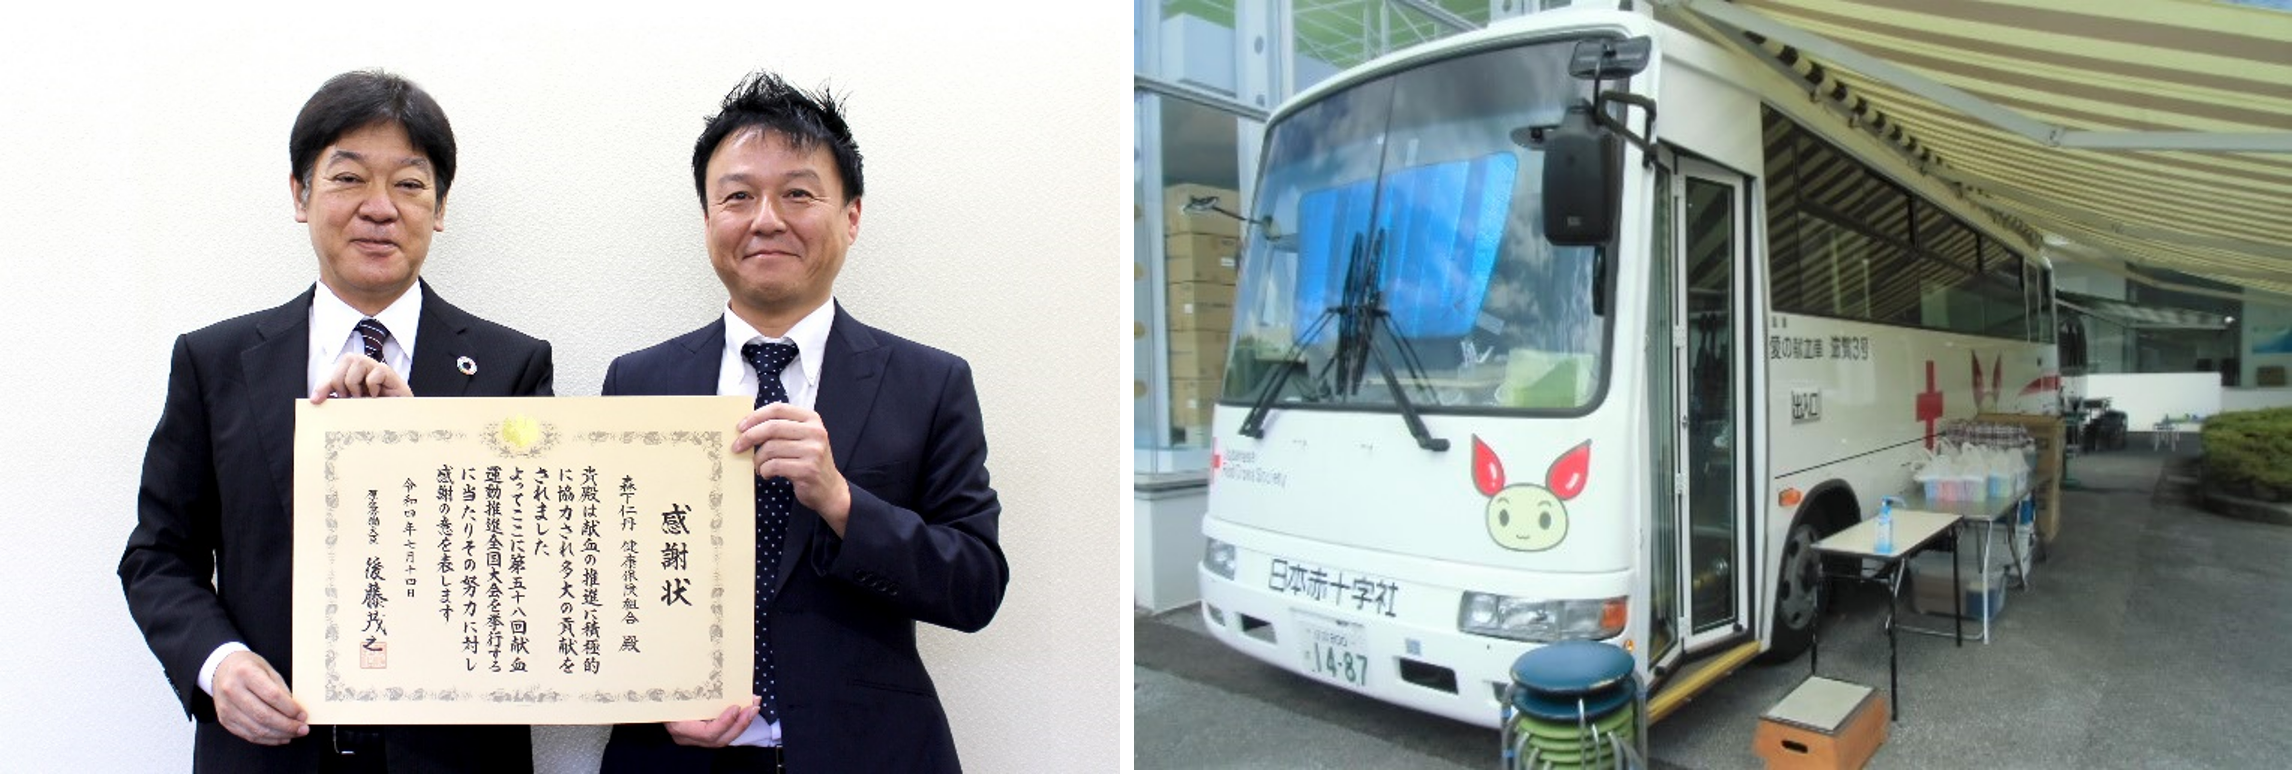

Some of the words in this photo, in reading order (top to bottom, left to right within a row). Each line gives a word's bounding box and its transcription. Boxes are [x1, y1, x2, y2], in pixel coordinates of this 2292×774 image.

[402, 477, 418, 598] 令和四年七月十四日
[435, 463, 455, 625] 感謝の意を表します
[533, 466, 551, 556] されました
[618, 474, 638, 532] 森下仁丹
[661, 502, 693, 607] 感謝状
[361, 555, 388, 652] 後藤茂之
[459, 467, 481, 672] に当たりその努力に対し
[483, 465, 505, 673] 運動推進全国大会を挙行する
[507, 466, 530, 673] よってここに第五十八回献血
[556, 468, 579, 674] に協力され多大の貢献を
[580, 465, 604, 675] 貴殿は献血の推進に積極的
[620, 539, 640, 625] 健康保険組合
[1268, 558, 1399, 618] 日本赤十字社
[619, 635, 641, 654] 殿
